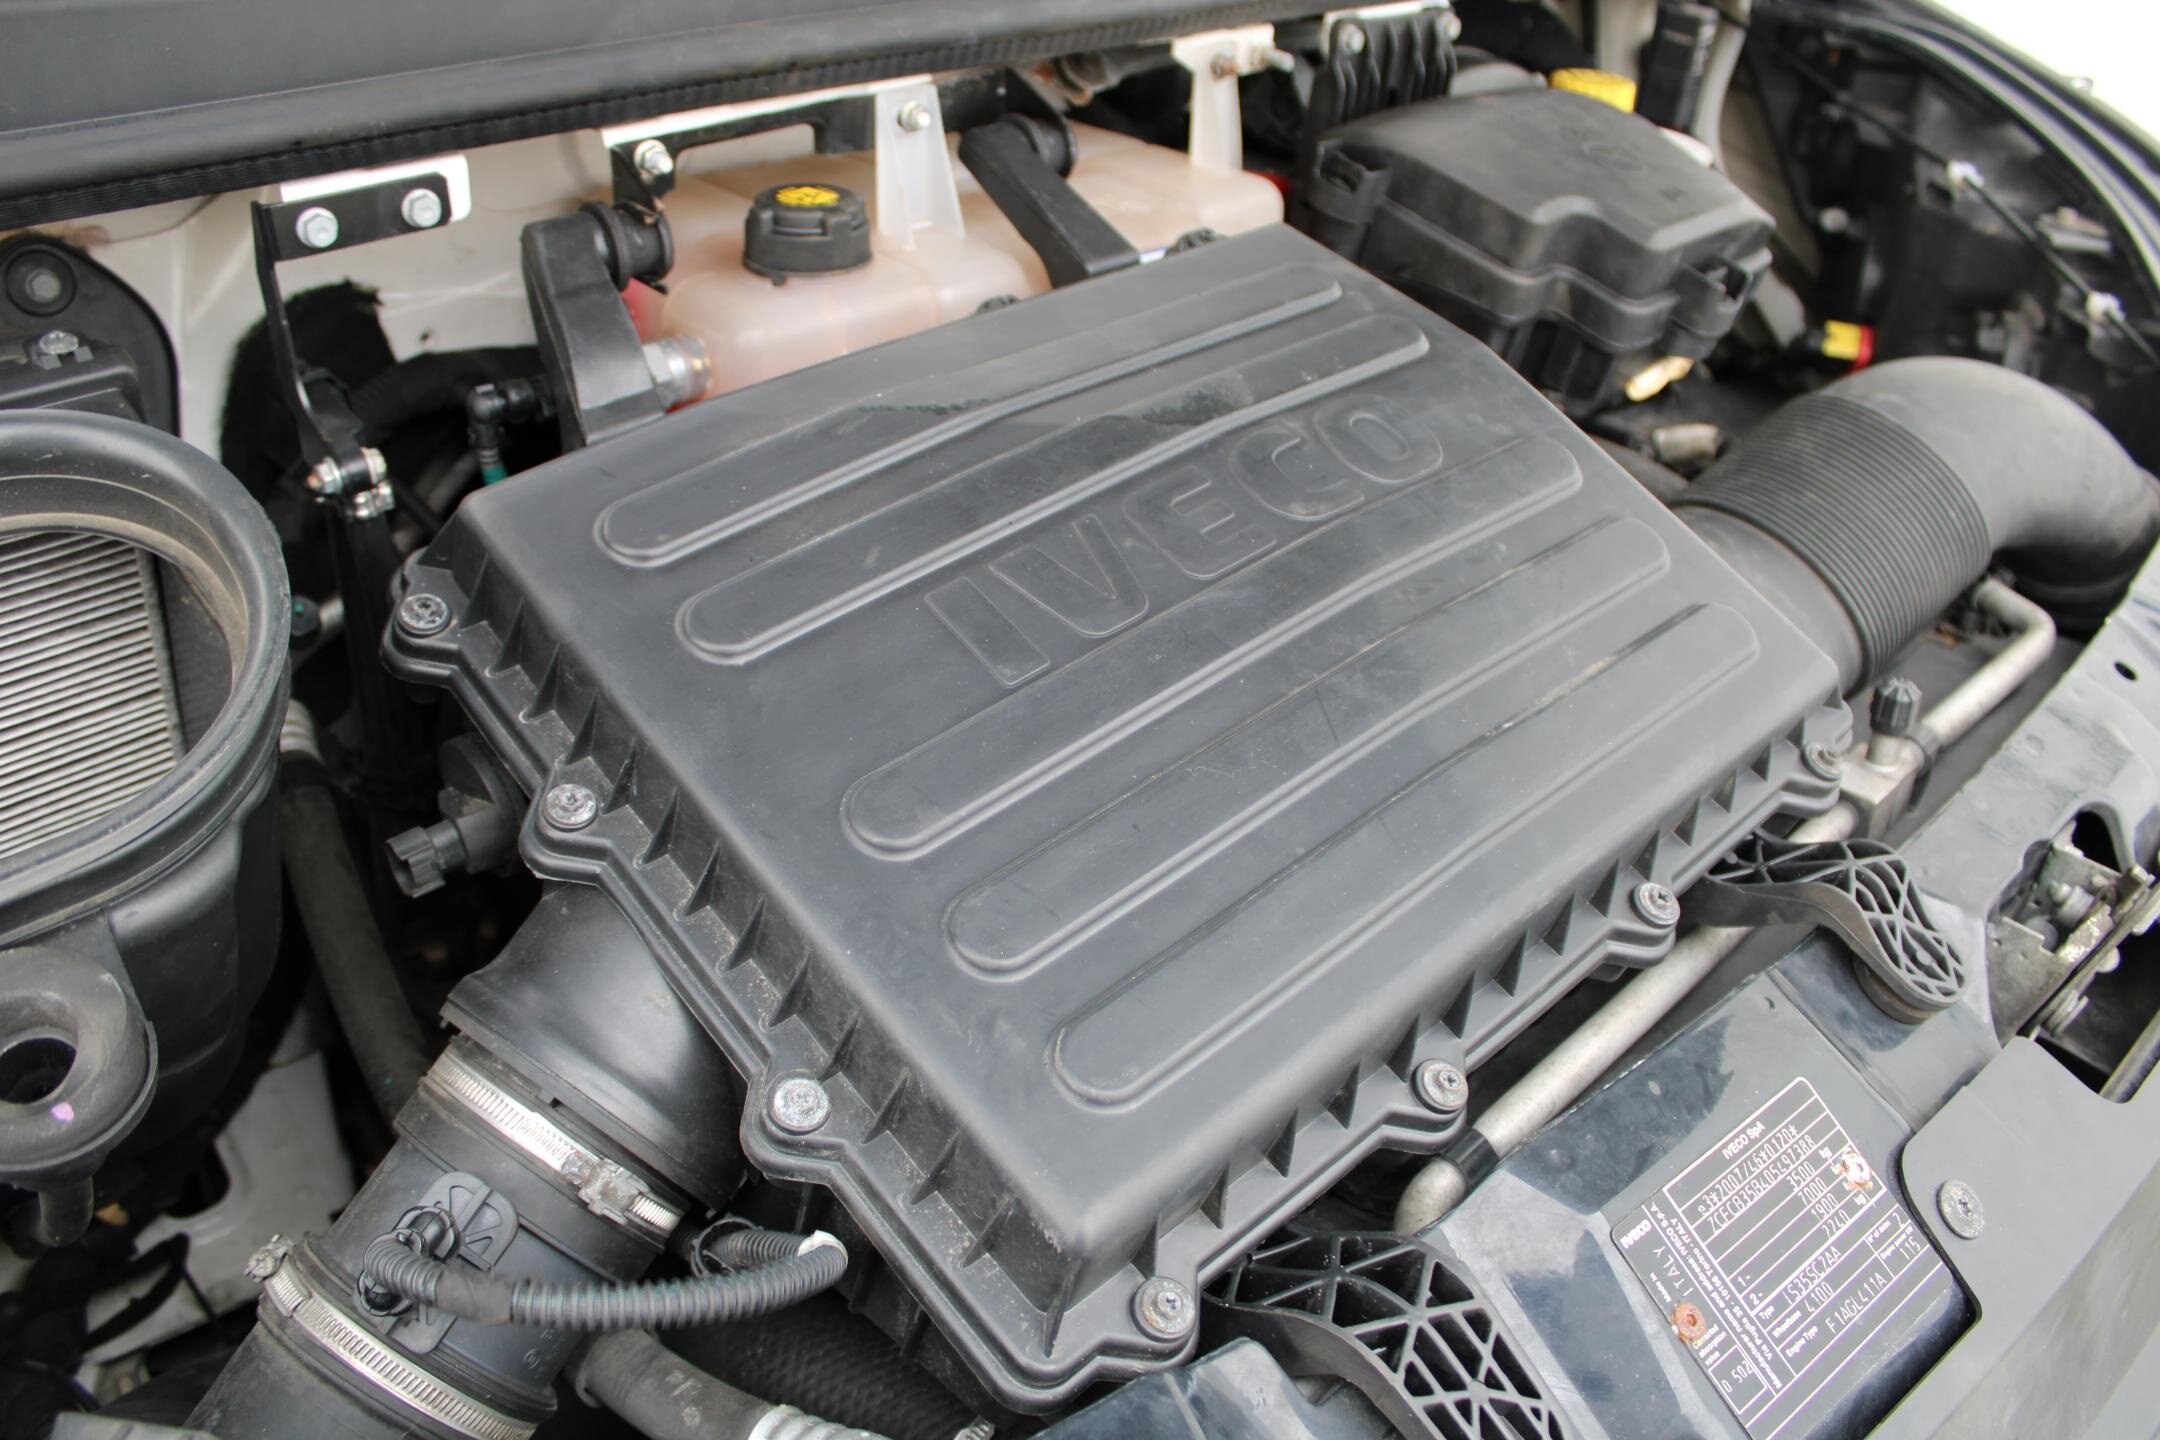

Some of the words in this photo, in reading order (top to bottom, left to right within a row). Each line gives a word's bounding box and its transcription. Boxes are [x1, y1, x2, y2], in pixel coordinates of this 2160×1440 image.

[924, 393, 1443, 688] IVECO
[1722, 1134, 1748, 1159] IVECO
[1746, 1121, 1766, 1140] SpA
[1787, 1162, 1816, 1191] 3500
[1818, 1146, 1833, 1159] kg
[1798, 1177, 1827, 1206] 7000
[1650, 1201, 1669, 1229] S.p.A.
[1812, 1194, 1840, 1220] 1900
[1892, 1212, 1905, 1228] 2
[1620, 1220, 1651, 1248] IVECO
[1670, 1218, 1691, 1243] ITALY
[1822, 1210, 1851, 1239] 2240
[1667, 1228, 1687, 1255] IVECO
[1900, 1236, 1920, 1259] 115
[1653, 1246, 1693, 1296] ITALY
[1687, 1255, 1713, 1291] address:
[1693, 1248, 1713, 1276] Torino
[1650, 1272, 1658, 1282] in
[1712, 1276, 1730, 1300] 10156
[1655, 1280, 1672, 1303] Made
[1710, 1291, 1726, 1309] and
[1724, 1309, 1742, 1332] name
[1732, 1305, 1744, 1318] 35
[1758, 1305, 1775, 1320] Type
[1772, 1311, 1801, 1337] Wheelbase
[1805, 1282, 1834, 1313] 4100
[1699, 1331, 1726, 1358] absorption
[1742, 1317, 1762, 1345] Puglia
[1786, 1338, 1805, 1357] Engine
[1802, 1325, 1819, 1340] Type
[1705, 1350, 1720, 1366] value
[1741, 1334, 1782, 1388] Manufacturer
[1761, 1343, 1773, 1361] Via
